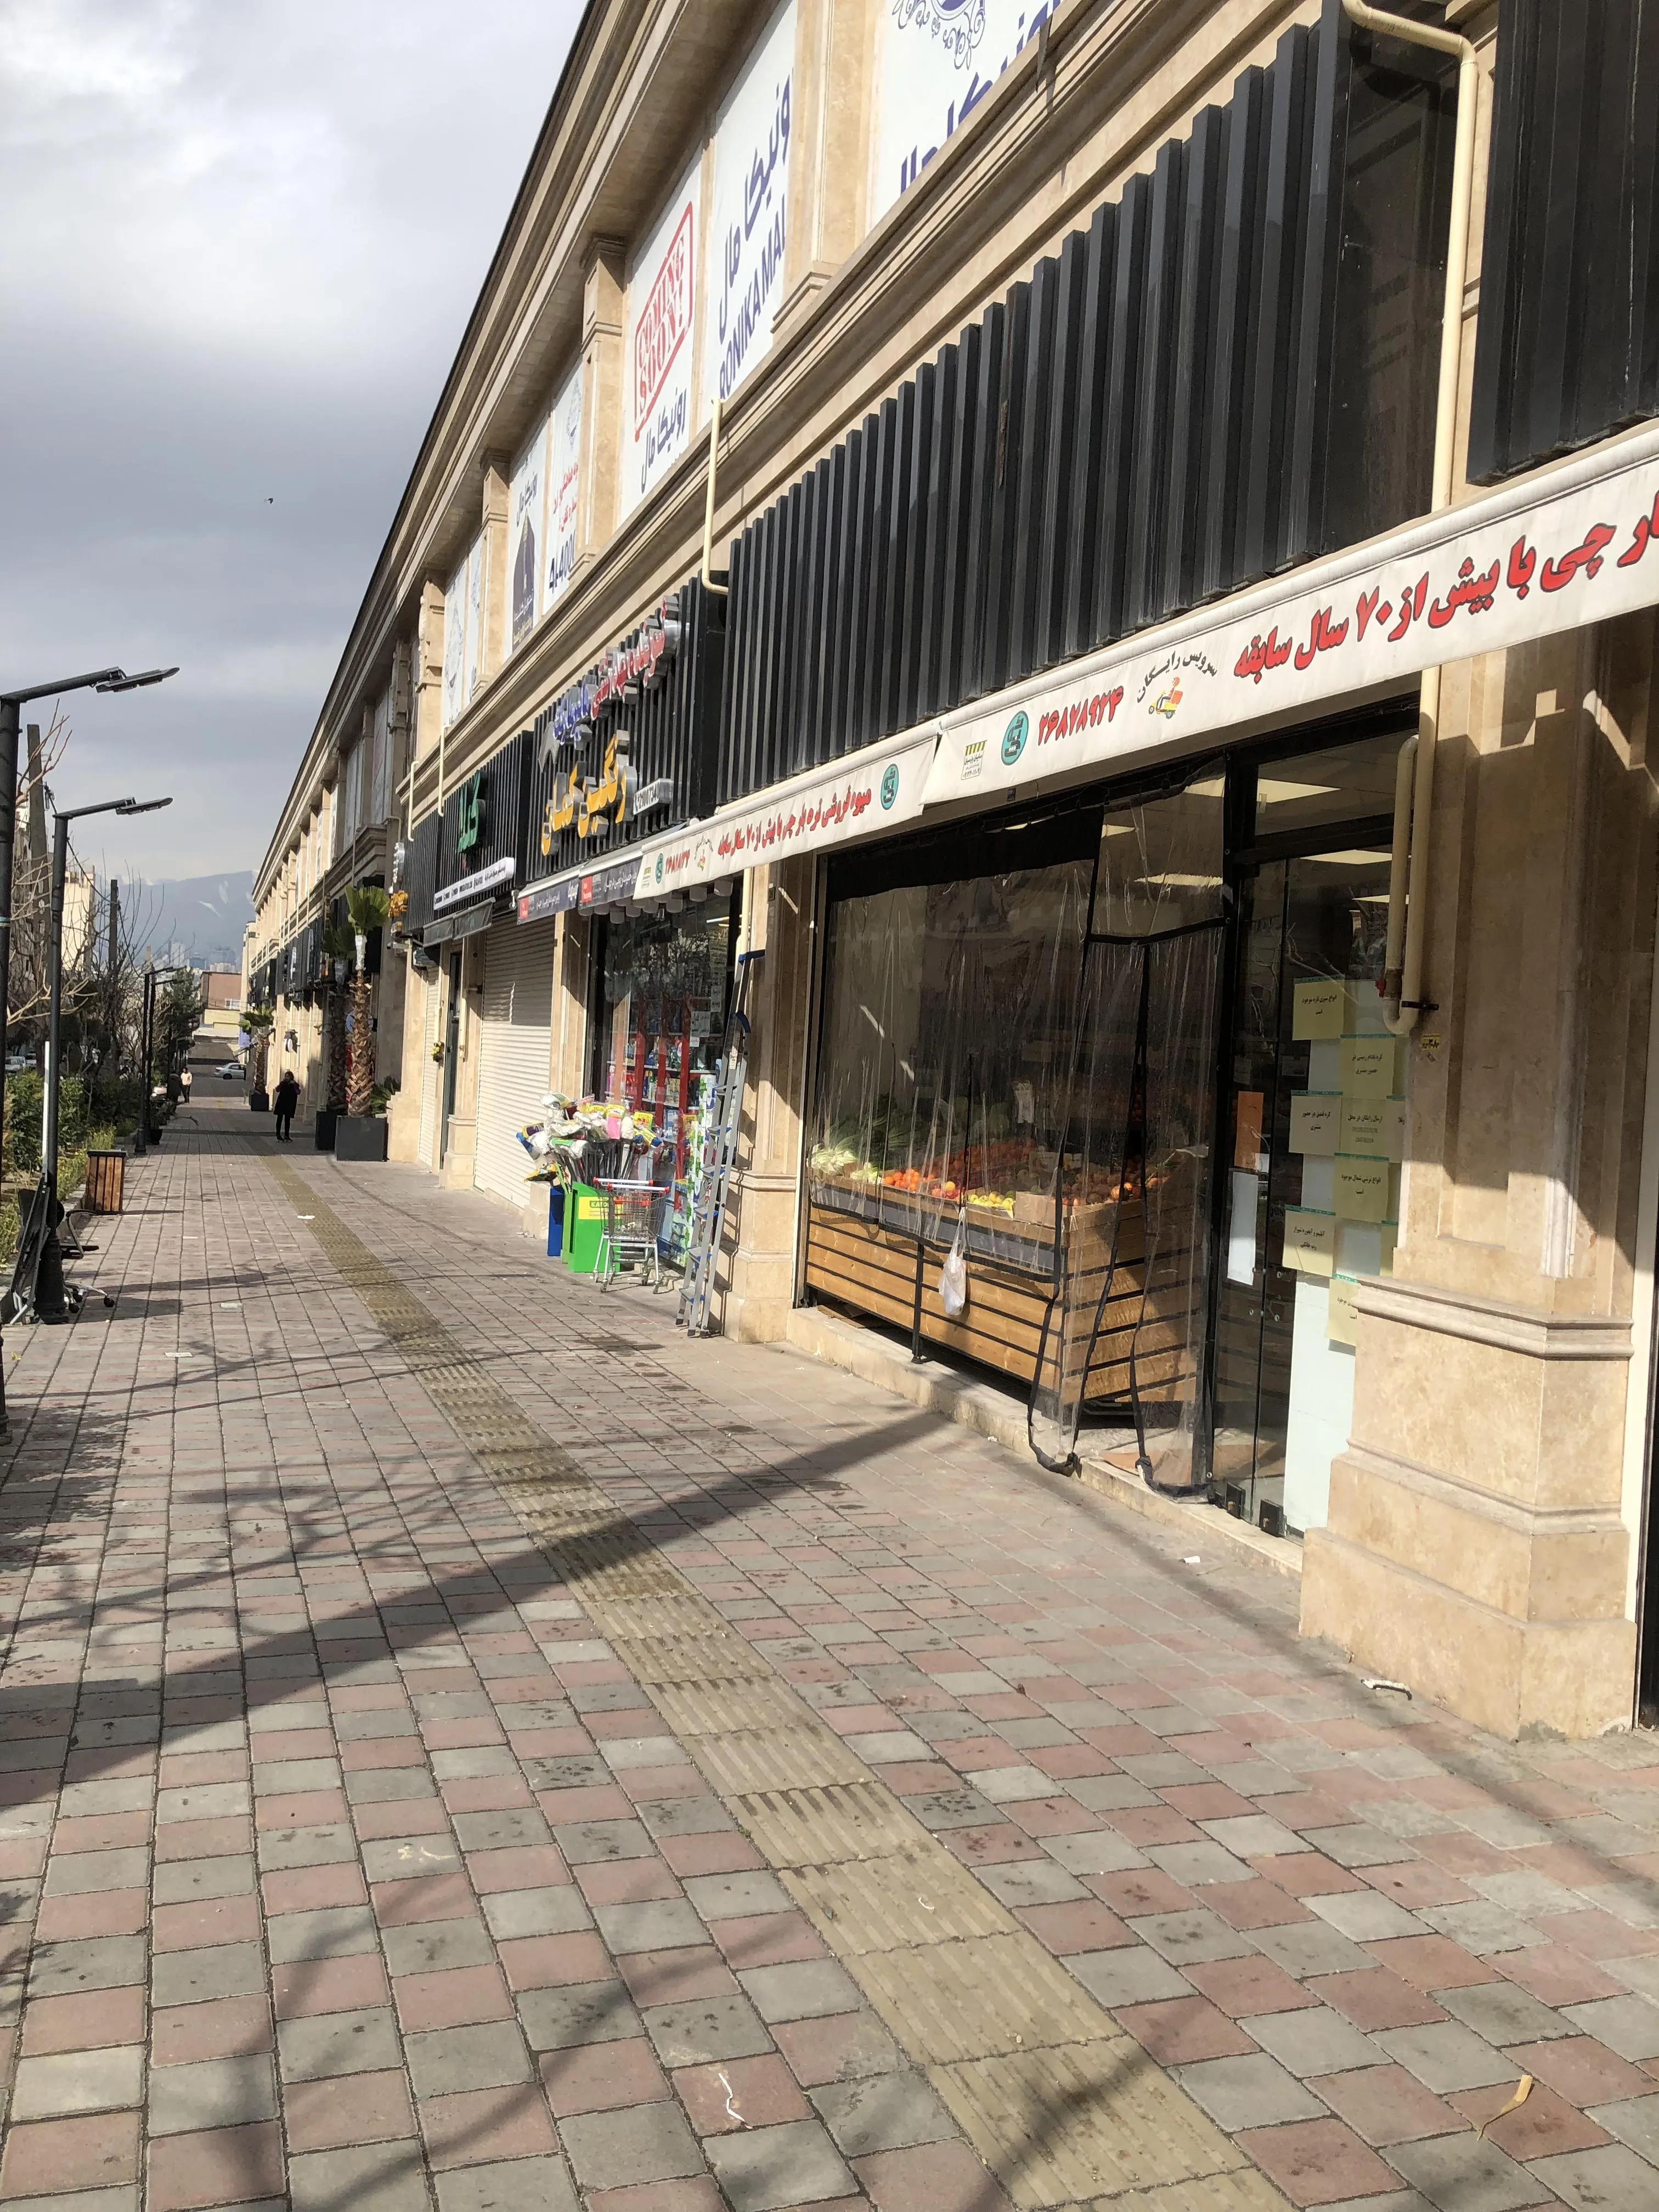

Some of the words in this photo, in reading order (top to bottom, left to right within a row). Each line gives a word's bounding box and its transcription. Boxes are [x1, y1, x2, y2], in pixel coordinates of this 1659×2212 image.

[639, 228, 685, 370] COMING
[720, 267, 761, 399] RONIKA
[1506, 534, 1537, 600] با
[1541, 522, 1618, 592] چی
[1356, 585, 1392, 642] ۷۰
[1388, 571, 1430, 642] از
[1427, 556, 1500, 629] بیش
[1234, 626, 1293, 684] سابقه
[1294, 602, 1349, 671] سال
[1137, 650, 1181, 703] رایگان
[1182, 651, 1218, 677] سرویس
[777, 812, 782, 842] با
[795, 802, 806, 837] بار
[821, 784, 852, 828] فروشی
[850, 788, 872, 817] میوه
[718, 832, 732, 860] سابقه
[730, 828, 746, 857] سال
[754, 820, 762, 852] از
[762, 817, 776, 849] بیش
